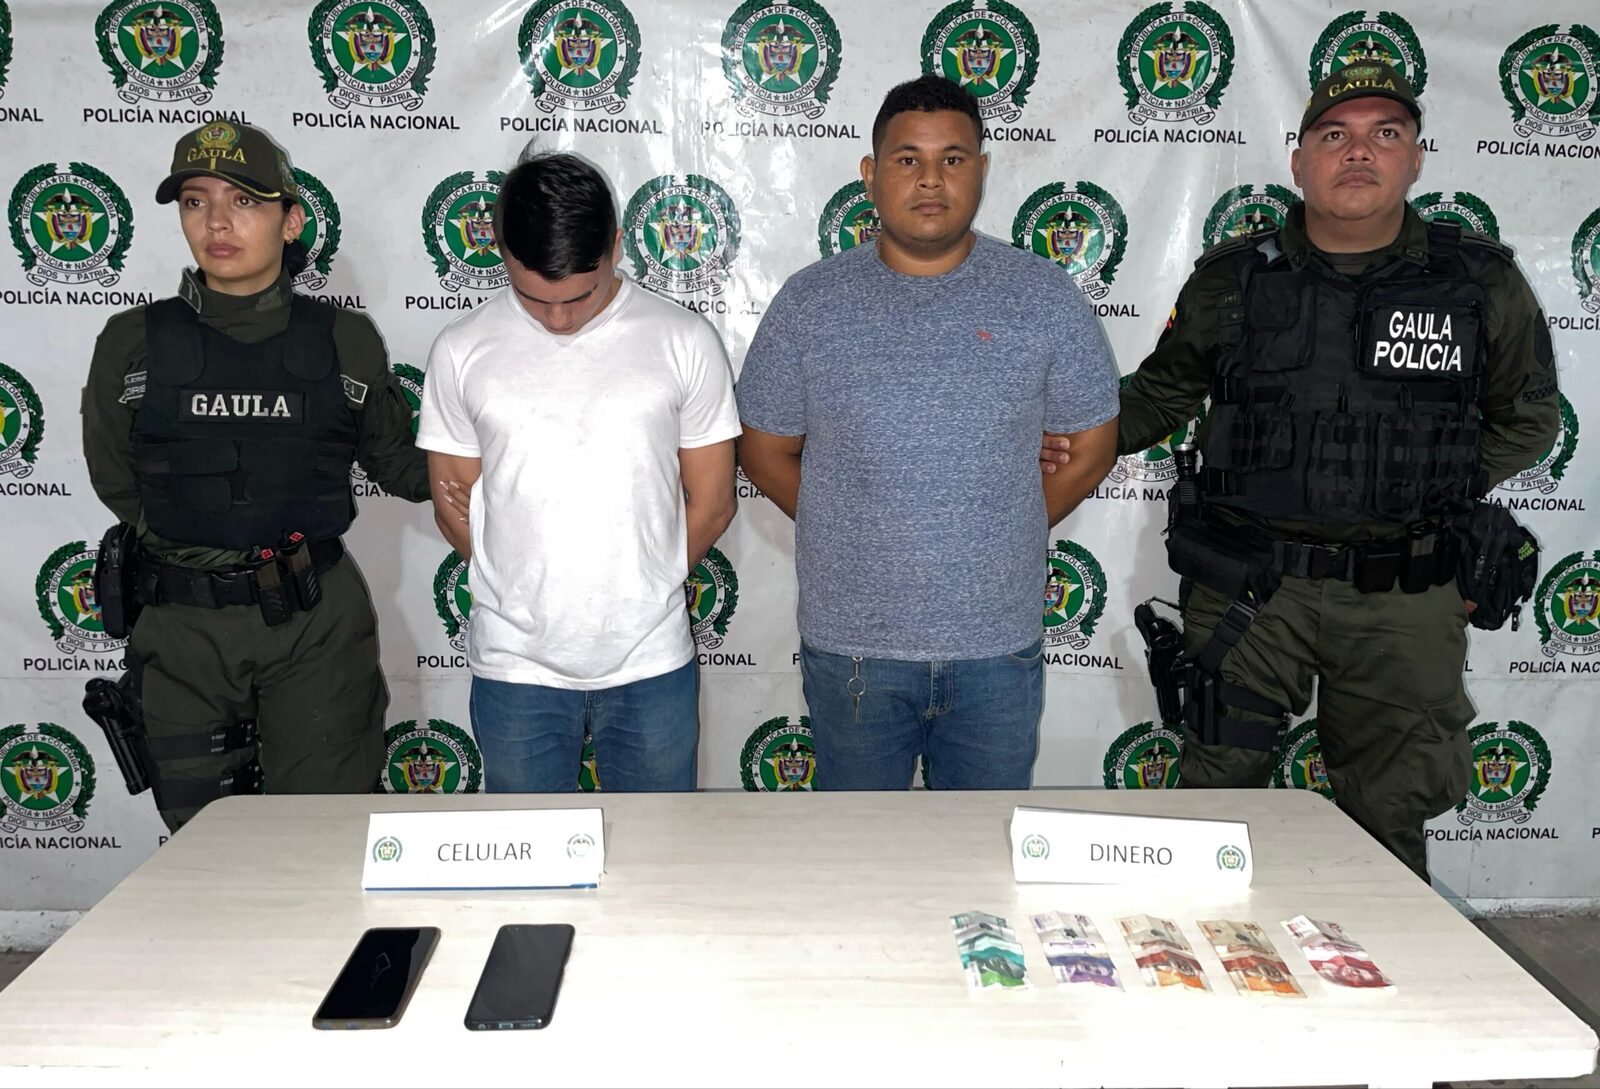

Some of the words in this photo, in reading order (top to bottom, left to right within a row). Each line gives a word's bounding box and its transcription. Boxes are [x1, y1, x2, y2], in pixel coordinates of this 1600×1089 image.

[592, 4, 624, 45] COLOMBIA
[774, 6, 786, 14] DE
[795, 10, 826, 51] COLOMBIA
[935, 16, 967, 55] REPUBLICA
[974, 11, 986, 19] DE
[995, 14, 1023, 55] COLOMBIA
[1132, 18, 1164, 58] REPUBLICA
[1191, 17, 1220, 57] COLOMBIA
[1363, 23, 1376, 31] DE
[1383, 27, 1412, 66] COLOMBIA
[122, 61, 155, 85] POLICIA
[166, 60, 204, 87] NACIONAL
[334, 65, 366, 91] POLICIA
[377, 66, 415, 92] NACIONAL
[129, 83, 149, 96] DIOS
[156, 91, 162, 99] Y
[169, 86, 201, 98] PATRIA
[541, 70, 572, 95] POLICIA
[582, 70, 621, 97] NACIONAL
[783, 75, 821, 102] NACIONAL
[980, 80, 1018, 106] NACIONAL
[1328, 77, 1398, 98] GAULA
[339, 89, 361, 102] DIOS
[367, 96, 373, 104] Y
[380, 90, 413, 105] PATRIA
[546, 93, 566, 106] DIOS
[584, 95, 615, 108] PATRIA
[1137, 83, 1165, 107] POLICIA
[1175, 81, 1212, 108] NACIONAL
[0, 107, 44, 122] ONAL
[83, 105, 154, 124] POLICÍA
[785, 101, 815, 113] PATRIA
[981, 104, 1012, 117] PATRIA
[1138, 105, 1158, 118] DIOS
[1164, 111, 1171, 119] Y
[1176, 106, 1205, 119] PATRIA
[292, 111, 366, 129] POLICÍA
[370, 115, 460, 130] NACIONAL
[500, 115, 569, 132] POLICÍA
[574, 118, 663, 134] NACIONAL
[1524, 119, 1543, 131] DIOS
[1560, 122, 1588, 134] PATRIA
[773, 123, 860, 139] NACIONAL
[983, 128, 1056, 142] ACIONAL
[1094, 127, 1159, 144] POLICÍA
[1164, 129, 1247, 144] NACIONAL
[187, 147, 247, 165] GAULA
[1477, 139, 1540, 156] POLICÍA
[1545, 144, 1600, 159] NACION
[23, 179, 52, 220] REPUBLICA
[58, 175, 71, 184] DE
[80, 178, 117, 220] COLOMBIA
[436, 187, 468, 227] REPUBLICA
[1026, 198, 1057, 237] REPUBLICA
[1083, 196, 1112, 235] COLOMBIA
[32, 244, 65, 269] POLICIA
[74, 243, 113, 270] NACIONAL
[446, 252, 475, 275] POLICIA
[37, 266, 58, 280] DIOS
[64, 273, 71, 281] Y
[77, 267, 109, 281] PATRIA
[644, 255, 673, 278] POLICIA
[451, 273, 470, 285] DIOS
[648, 277, 668, 288] DIOS
[0, 288, 62, 305] OLICÍA
[405, 292, 472, 310] POLICÍA
[1094, 304, 1140, 317] IONAL
[1389, 311, 1453, 342] GAULA
[1549, 315, 1599, 330] POLICÍ
[1374, 341, 1463, 372] POLICIA
[191, 395, 292, 417] GAULA
[1520, 455, 1557, 478] NACIONAL
[0, 483, 71, 496] ACIONAL
[1521, 477, 1550, 488] PATRIA
[1508, 498, 1585, 511] NACIONAL
[50, 555, 80, 593] REPUBLICA
[701, 558, 723, 589] OLOMBIA
[1063, 554, 1092, 590] COLOMBIA
[60, 616, 91, 638] POLICIA
[1050, 612, 1086, 634] NACIONAL
[66, 636, 85, 648] DIOS
[1051, 633, 1080, 644] PATRIA
[23, 655, 90, 670] POLICÍA
[417, 655, 470, 668] POLIC
[697, 654, 756, 666] CIONAL
[1043, 653, 1124, 669] NACIONAL
[1509, 659, 1566, 673] POLICÍA
[48, 738, 80, 773] COLOMBIA
[1512, 735, 1537, 767] COLOMBIA
[3, 795, 32, 817] POLICIA
[42, 795, 77, 817] NACIONAL
[1495, 788, 1530, 810] NACIONAL
[7, 816, 27, 826] DIOS
[45, 815, 74, 828] PATRIA
[1466, 809, 1482, 819] DIOS
[1497, 809, 1523, 819] PATRIA
[35, 837, 121, 849] NACIONAL
[1425, 827, 1483, 841] POLICÍA
[1486, 828, 1559, 841] NACIONAL
[437, 842, 532, 862] CELULAR
[1090, 843, 1173, 866] DINERO
